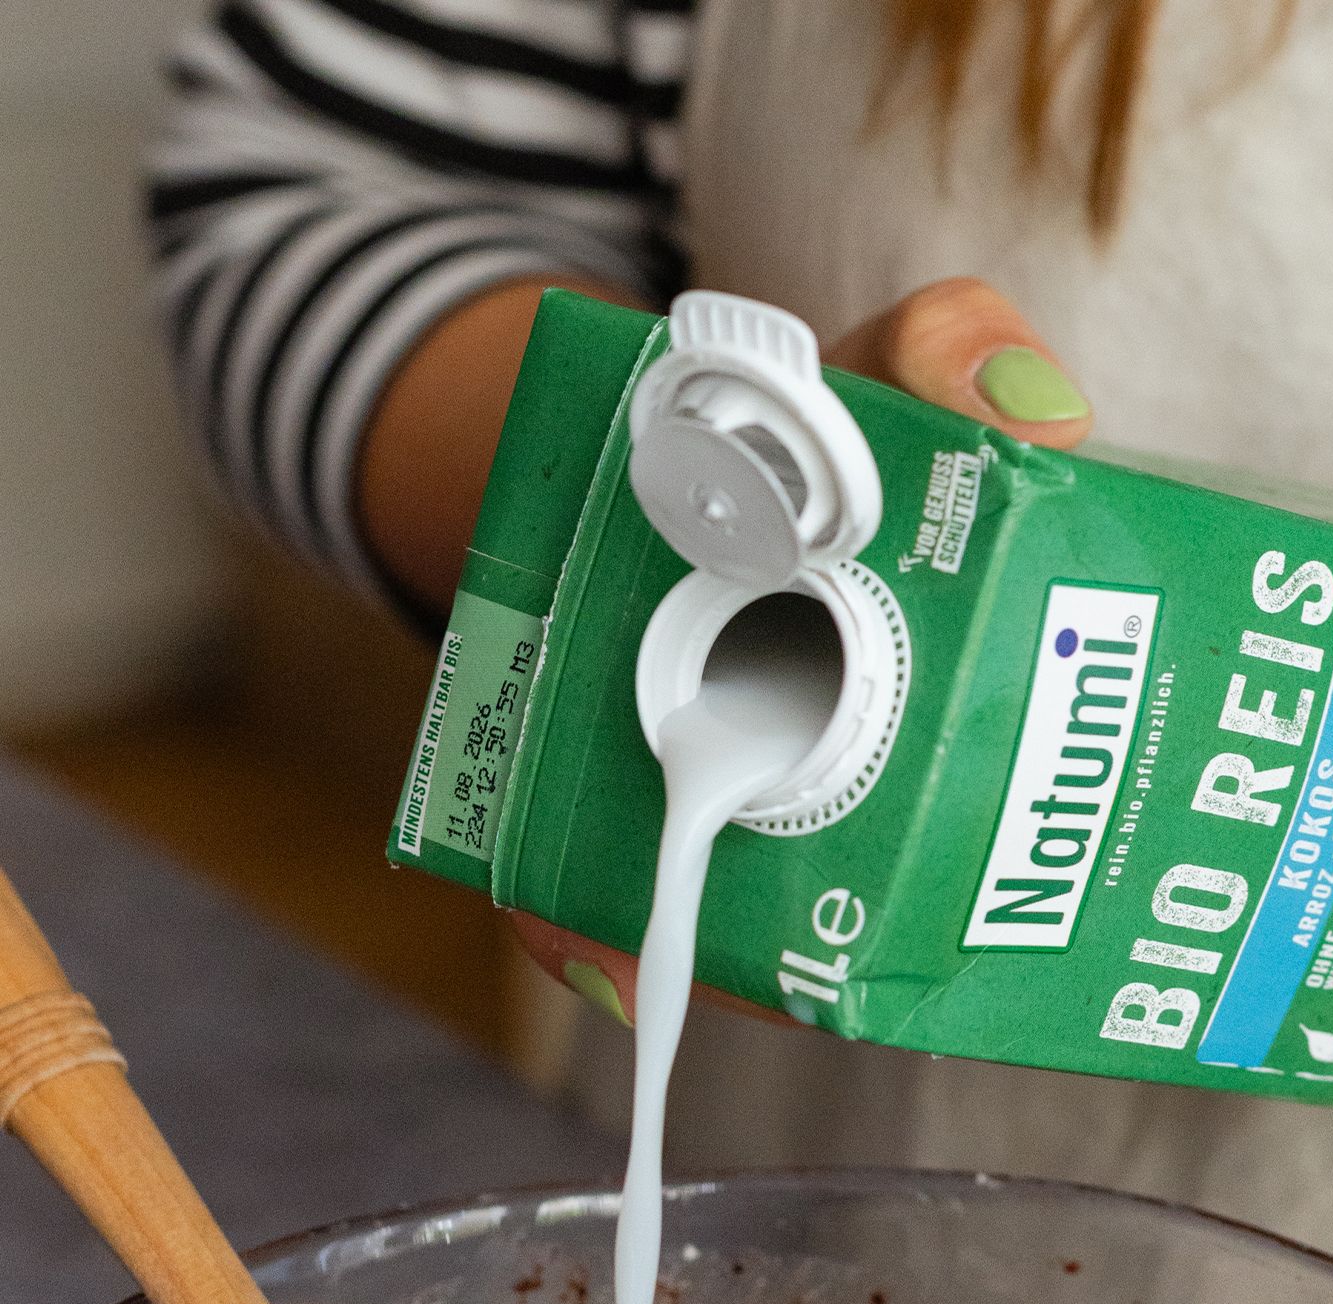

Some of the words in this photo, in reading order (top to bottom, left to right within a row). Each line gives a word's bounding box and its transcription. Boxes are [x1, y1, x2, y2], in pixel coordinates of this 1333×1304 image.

[912, 522, 940, 556] VOR
[923, 450, 955, 521] GENUSS
[401, 743, 435, 847] MINDESTENS
[426, 670, 453, 742] HALTBAR
[444, 635, 463, 667] BIS:
[446, 702, 492, 839] 11.08.2026
[464, 803, 488, 850] 224
[509, 640, 535, 674] M3
[1099, 863, 1249, 1050] BIO
